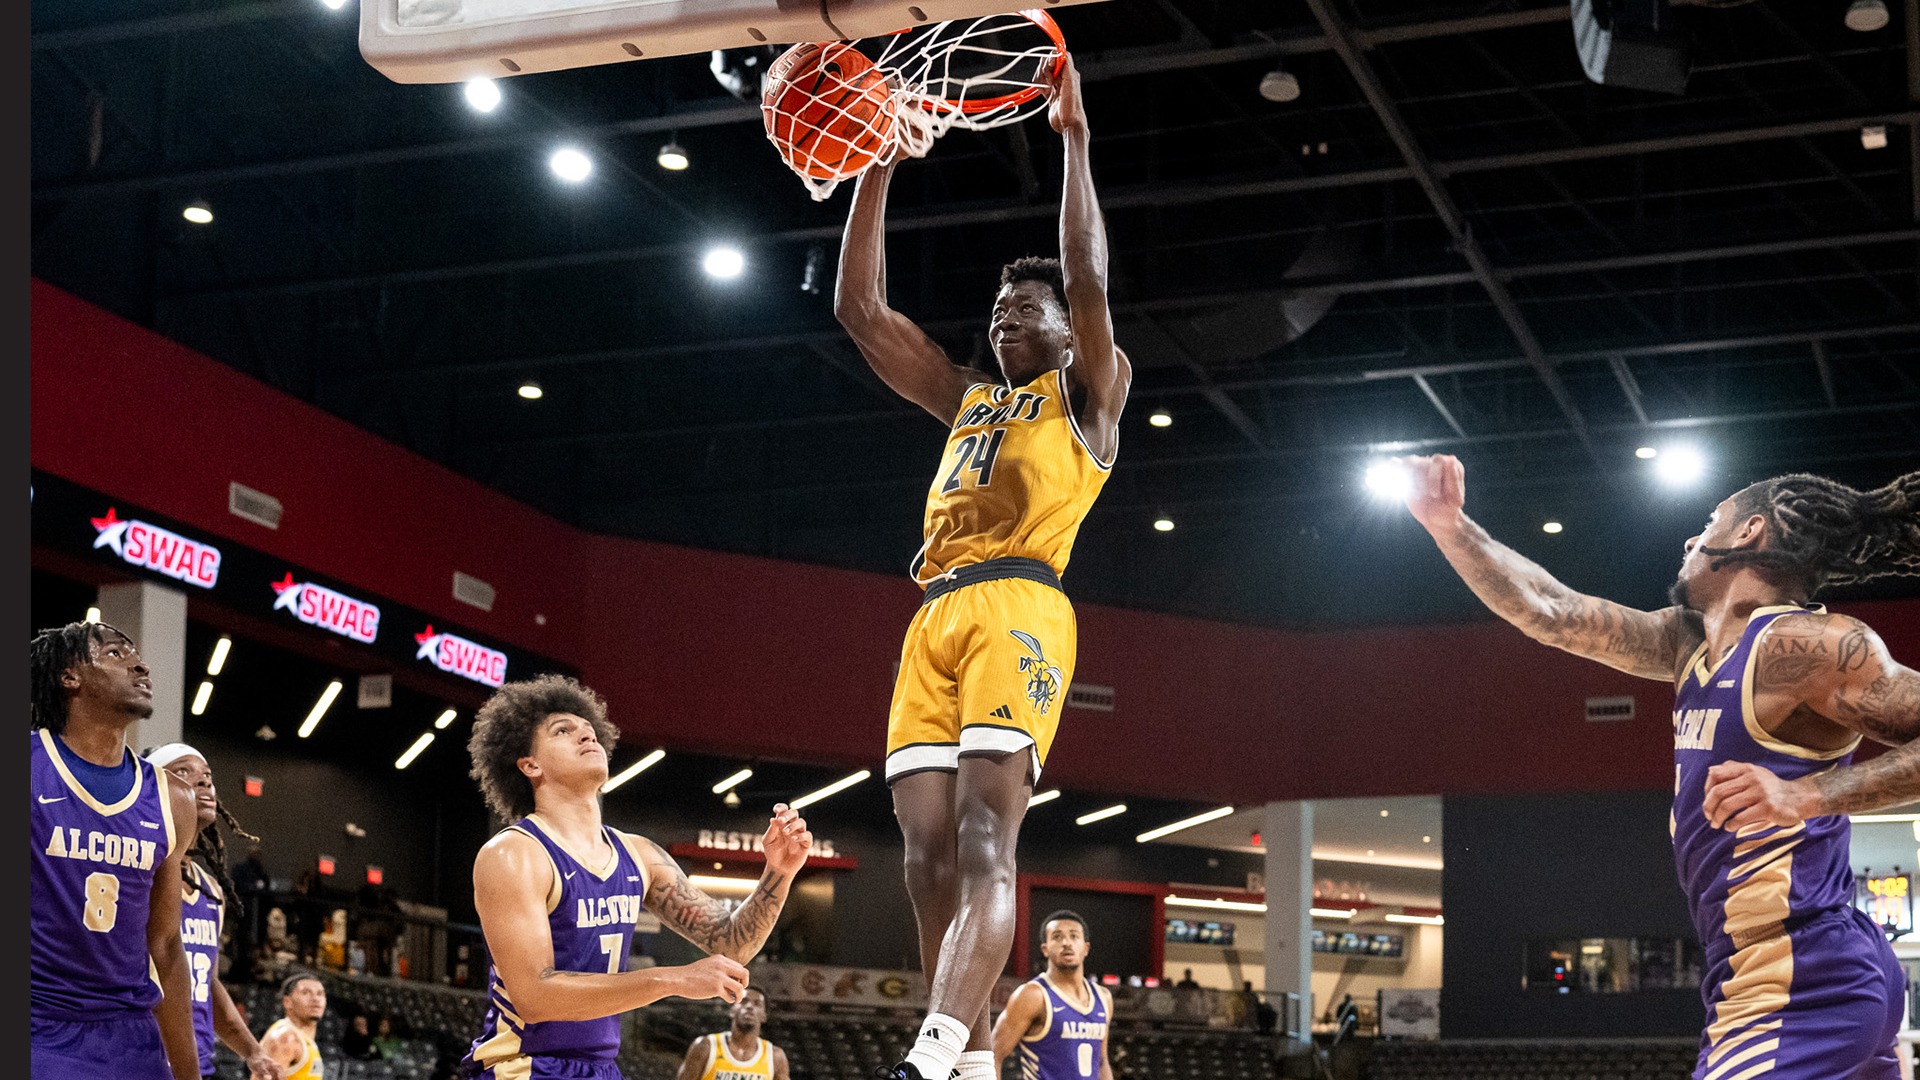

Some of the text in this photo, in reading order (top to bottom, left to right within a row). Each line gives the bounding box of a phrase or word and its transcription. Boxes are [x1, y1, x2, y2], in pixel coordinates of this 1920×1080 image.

[940, 428, 1008, 496] 24
[125, 521, 220, 587] SWAC
[300, 584, 379, 642] SWAC
[440, 636, 507, 686] SWAC
[46, 826, 156, 871] ALCORN
[83, 872, 120, 933] 8
[1867, 876, 1908, 897] 4:02
[181, 918, 217, 947] LCORN
[577, 895, 640, 928] ALCORN
[599, 933, 623, 974] 7
[1061, 1021, 1106, 1040] ALCORN
[1077, 1043, 1093, 1077] 0
